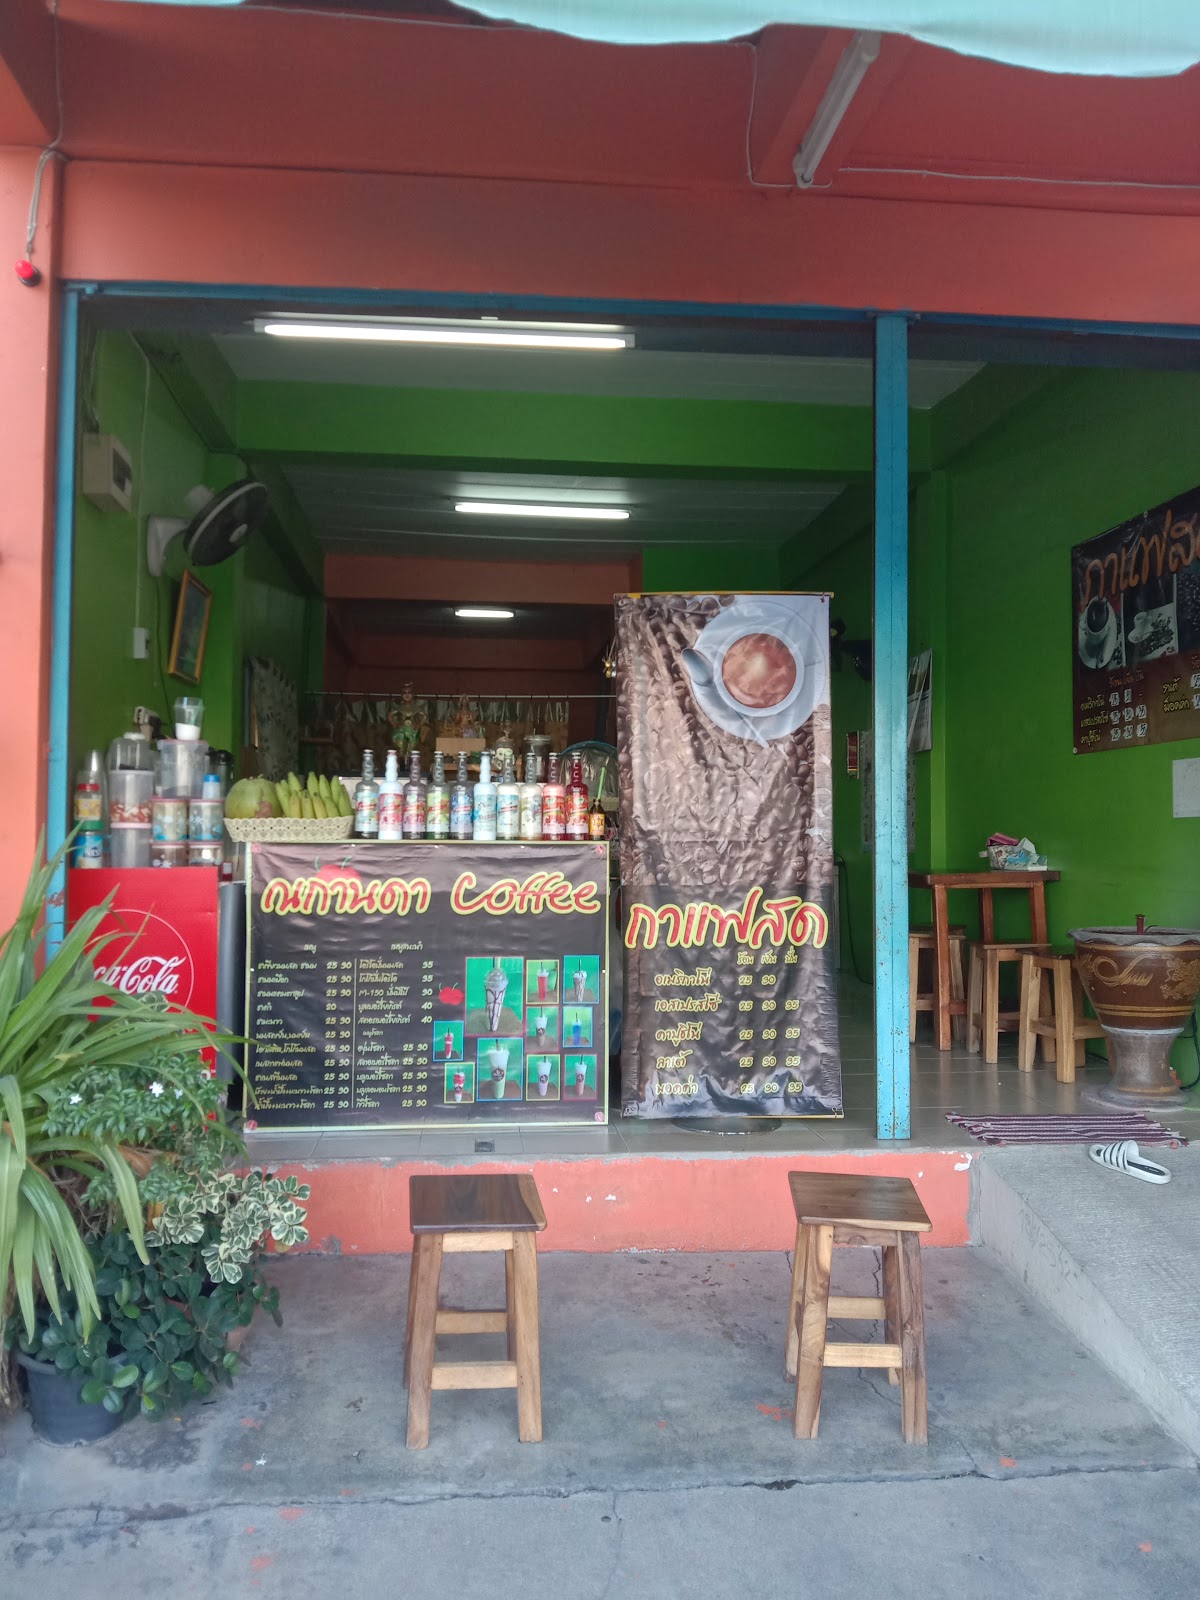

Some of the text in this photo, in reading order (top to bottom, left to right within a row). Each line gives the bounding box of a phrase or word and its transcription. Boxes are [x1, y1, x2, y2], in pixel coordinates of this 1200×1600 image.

[1085, 508, 1200, 607] กาแฟส
[450, 871, 601, 915] Coffee
[625, 886, 828, 949] กาแฟสด
[737, 946, 797, 965] ร้อน เย็น ปั่น
[326, 961, 338, 969] 25
[341, 961, 352, 969] 30
[422, 961, 434, 969] 35
[94, 956, 187, 995] ca-Cola
[326, 975, 337, 983] 25
[340, 975, 352, 983] 30
[422, 974, 434, 983] 35
[654, 967, 776, 986] อเมริกาโน่ 25 30
[325, 989, 337, 997] 25
[340, 989, 351, 997] 30
[422, 988, 433, 996] 30
[421, 1002, 433, 1010] 40
[655, 992, 799, 1012] เอสเปรสโซ่ 25 30 35
[325, 1003, 337, 1011] 20
[325, 1017, 336, 1025] 25
[421, 1015, 433, 1024] 40
[325, 1030, 336, 1038] 25
[339, 1030, 350, 1038] 30
[739, 1029, 753, 1040] 25
[762, 1029, 777, 1040] 30
[785, 1028, 800, 1039] 35
[338, 1044, 350, 1052] 30
[403, 1043, 414, 1051] 25
[417, 1043, 428, 1051] 30
[324, 1059, 335, 1067] 25
[338, 1058, 350, 1066] 30
[402, 1057, 414, 1065] 25
[416, 1057, 428, 1065] 30
[656, 1049, 801, 1069] ลาเต้ 25 30 35
[324, 1072, 335, 1081] 25
[338, 1072, 349, 1080] 30
[402, 1072, 414, 1080] 25
[416, 1072, 428, 1080] 30
[402, 1085, 413, 1093] 25
[416, 1084, 428, 1093] 30
[656, 1075, 803, 1094] มอคค่า 25 30 35
[324, 1087, 335, 1095] 25
[338, 1086, 349, 1094] 30
[323, 1101, 335, 1109] 25
[337, 1100, 349, 1108] 30
[402, 1099, 413, 1107] 25
[416, 1098, 428, 1107] 30
